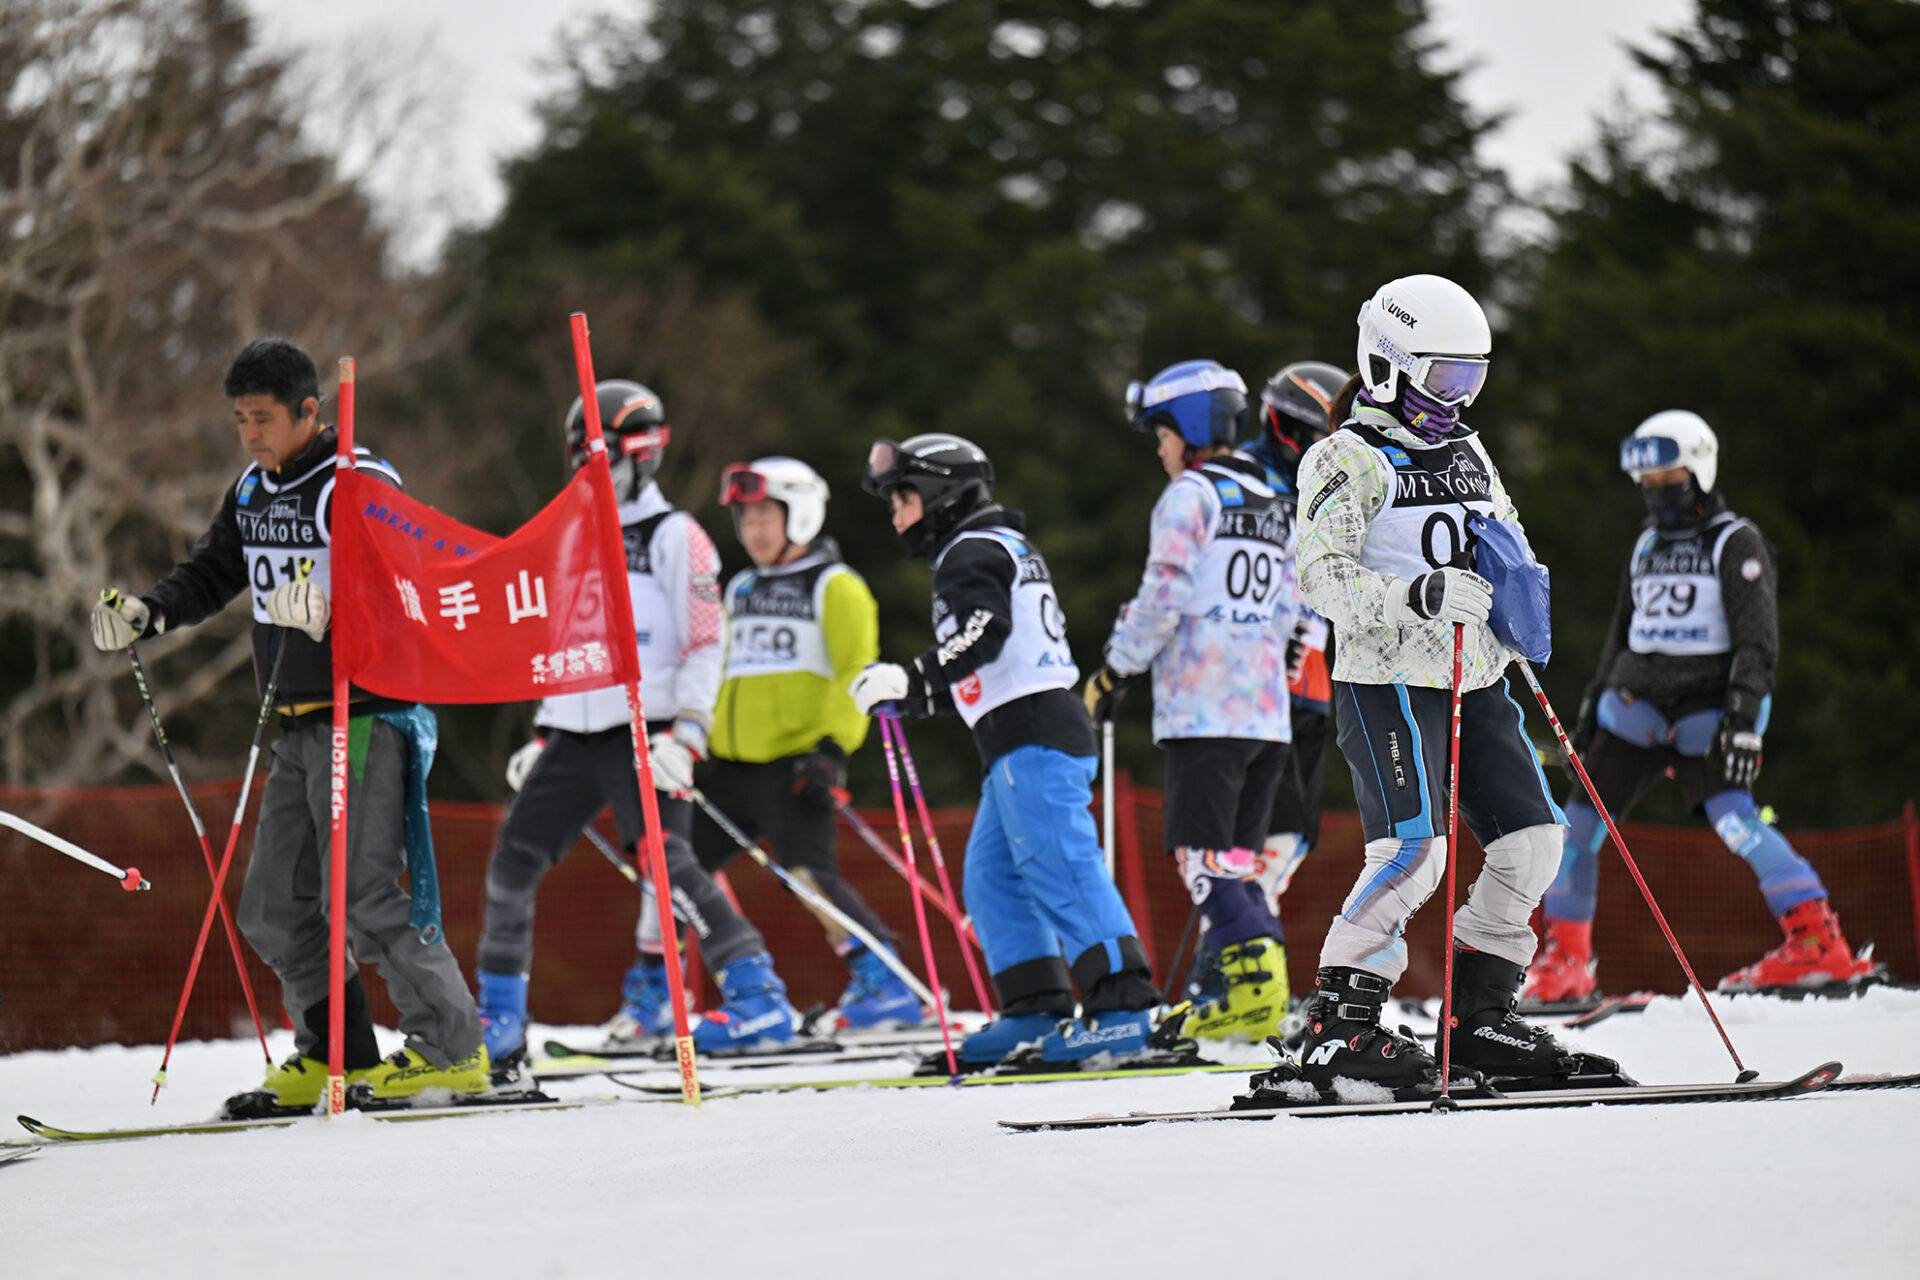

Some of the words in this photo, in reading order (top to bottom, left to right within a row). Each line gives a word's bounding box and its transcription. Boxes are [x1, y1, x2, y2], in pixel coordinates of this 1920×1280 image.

[1387, 303, 1418, 329] uvex
[1308, 472, 1347, 519] FABLICE
[331, 732, 346, 820] COMBAT
[1388, 731, 1406, 788] FABLICE
[1473, 1026, 1537, 1052] NORDICA
[679, 1041, 696, 1099] COMBAT
